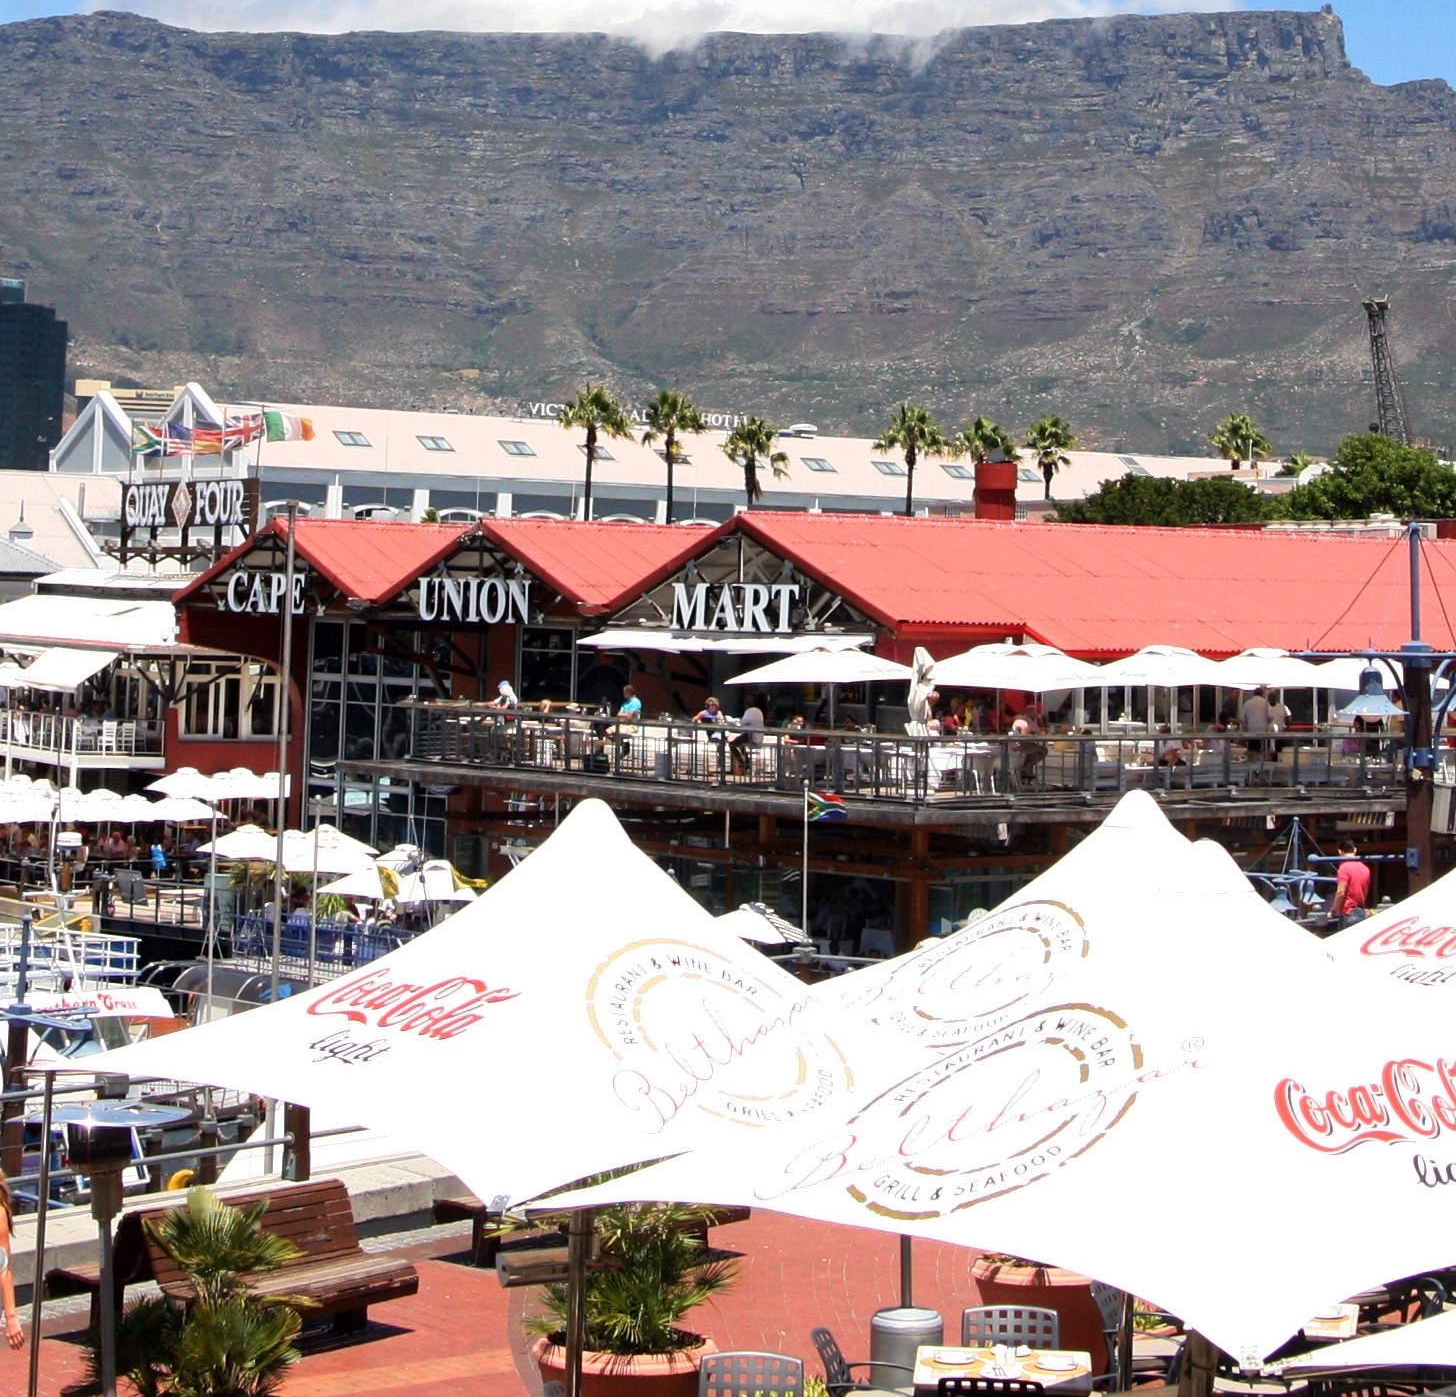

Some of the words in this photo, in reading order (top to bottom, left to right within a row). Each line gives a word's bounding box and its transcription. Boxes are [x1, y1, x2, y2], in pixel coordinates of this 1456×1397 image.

[126, 485, 169, 527] QUAY
[195, 480, 245, 525] FOUR
[227, 572, 305, 615] CAPE
[418, 577, 532, 625] UNION
[669, 582, 800, 633] MART
[97, 993, 138, 1011] Cross
[306, 967, 523, 1041] Coca-Cola
[613, 962, 650, 1046] RESTAURANT
[666, 953, 713, 975] WINE
[720, 966, 761, 998] BAR
[307, 1029, 393, 1065] light
[895, 1025, 1027, 1103] RESTAURANT
[1034, 1021, 1045, 1035] &
[1053, 1015, 1100, 1045] WINE
[1092, 1036, 1116, 1072] BAR
[726, 1101, 781, 1123] GRILL
[873, 1173, 924, 1204] GRILL
[930, 1186, 942, 1202] &
[953, 1143, 1063, 1198] SEAFOOD
